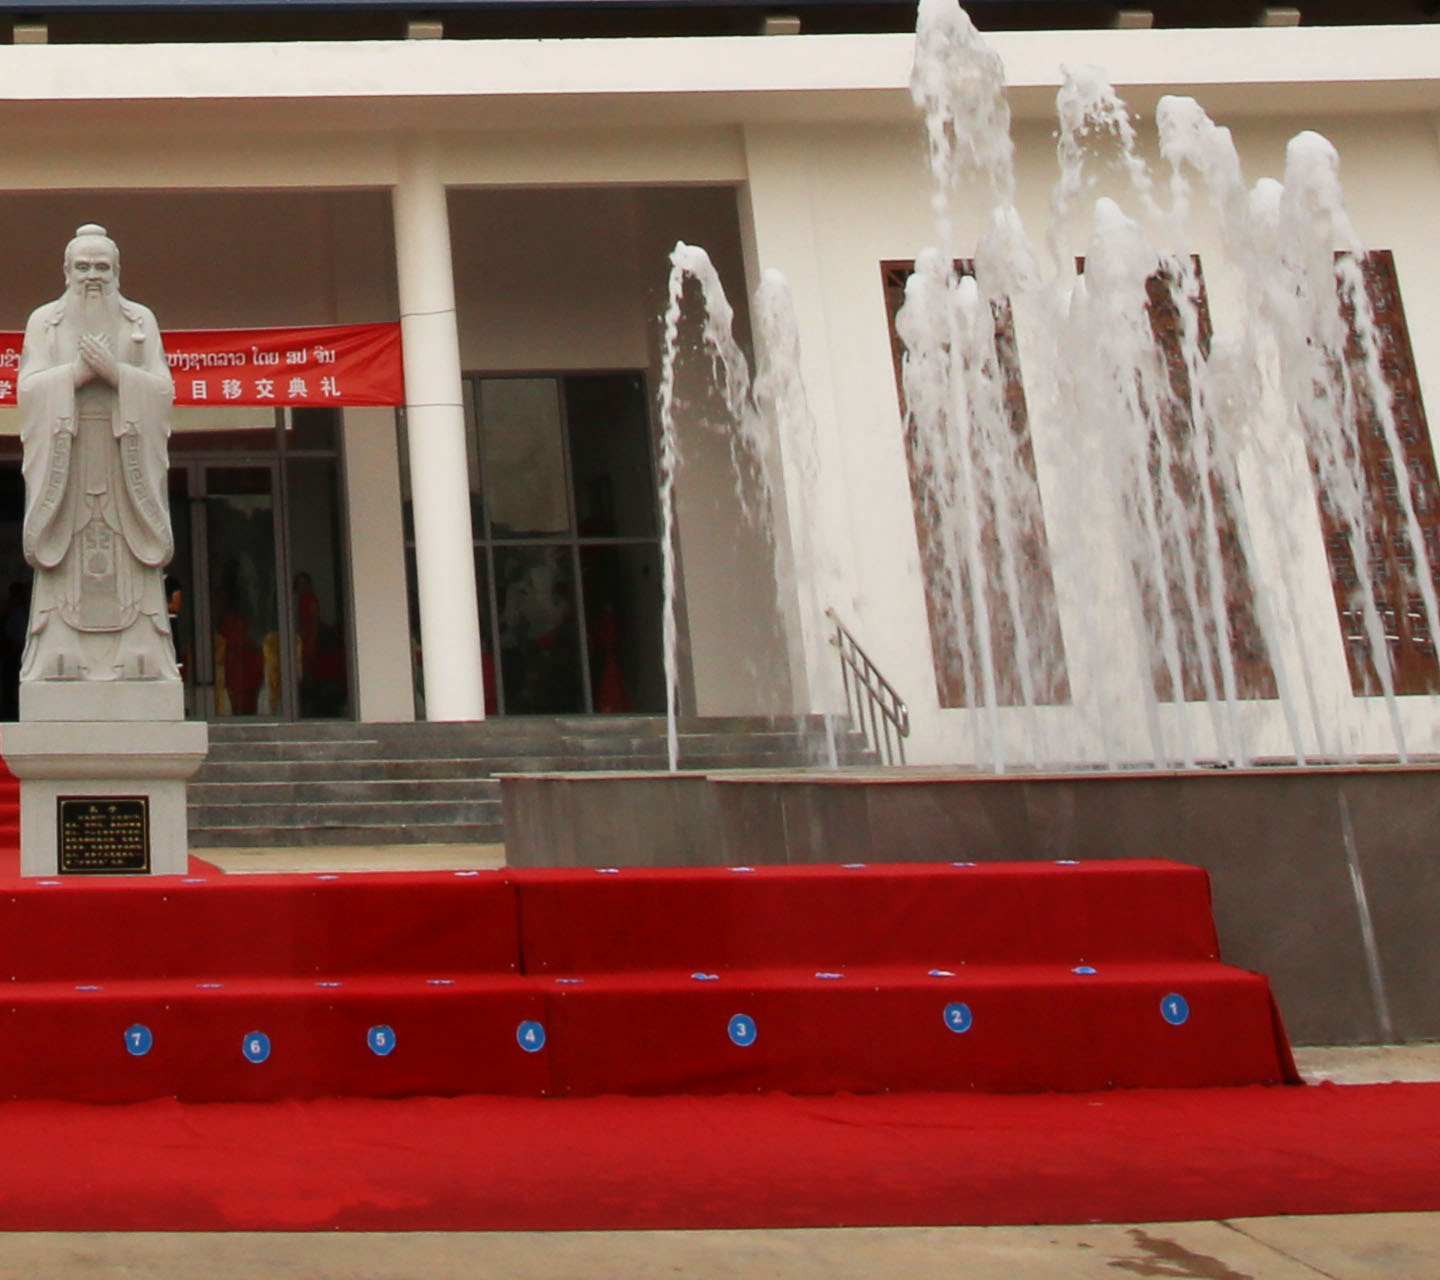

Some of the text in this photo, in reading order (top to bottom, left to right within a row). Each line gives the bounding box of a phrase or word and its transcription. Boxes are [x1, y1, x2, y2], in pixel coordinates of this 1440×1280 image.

[171, 376, 342, 400] 目移交典礼
[951, 1011, 962, 1024] 2
[525, 1029, 536, 1043] 4
[736, 1024, 747, 1037] 3
[131, 1033, 141, 1046] 7
[375, 1033, 386, 1046] 5
[250, 1040, 261, 1054] 6
